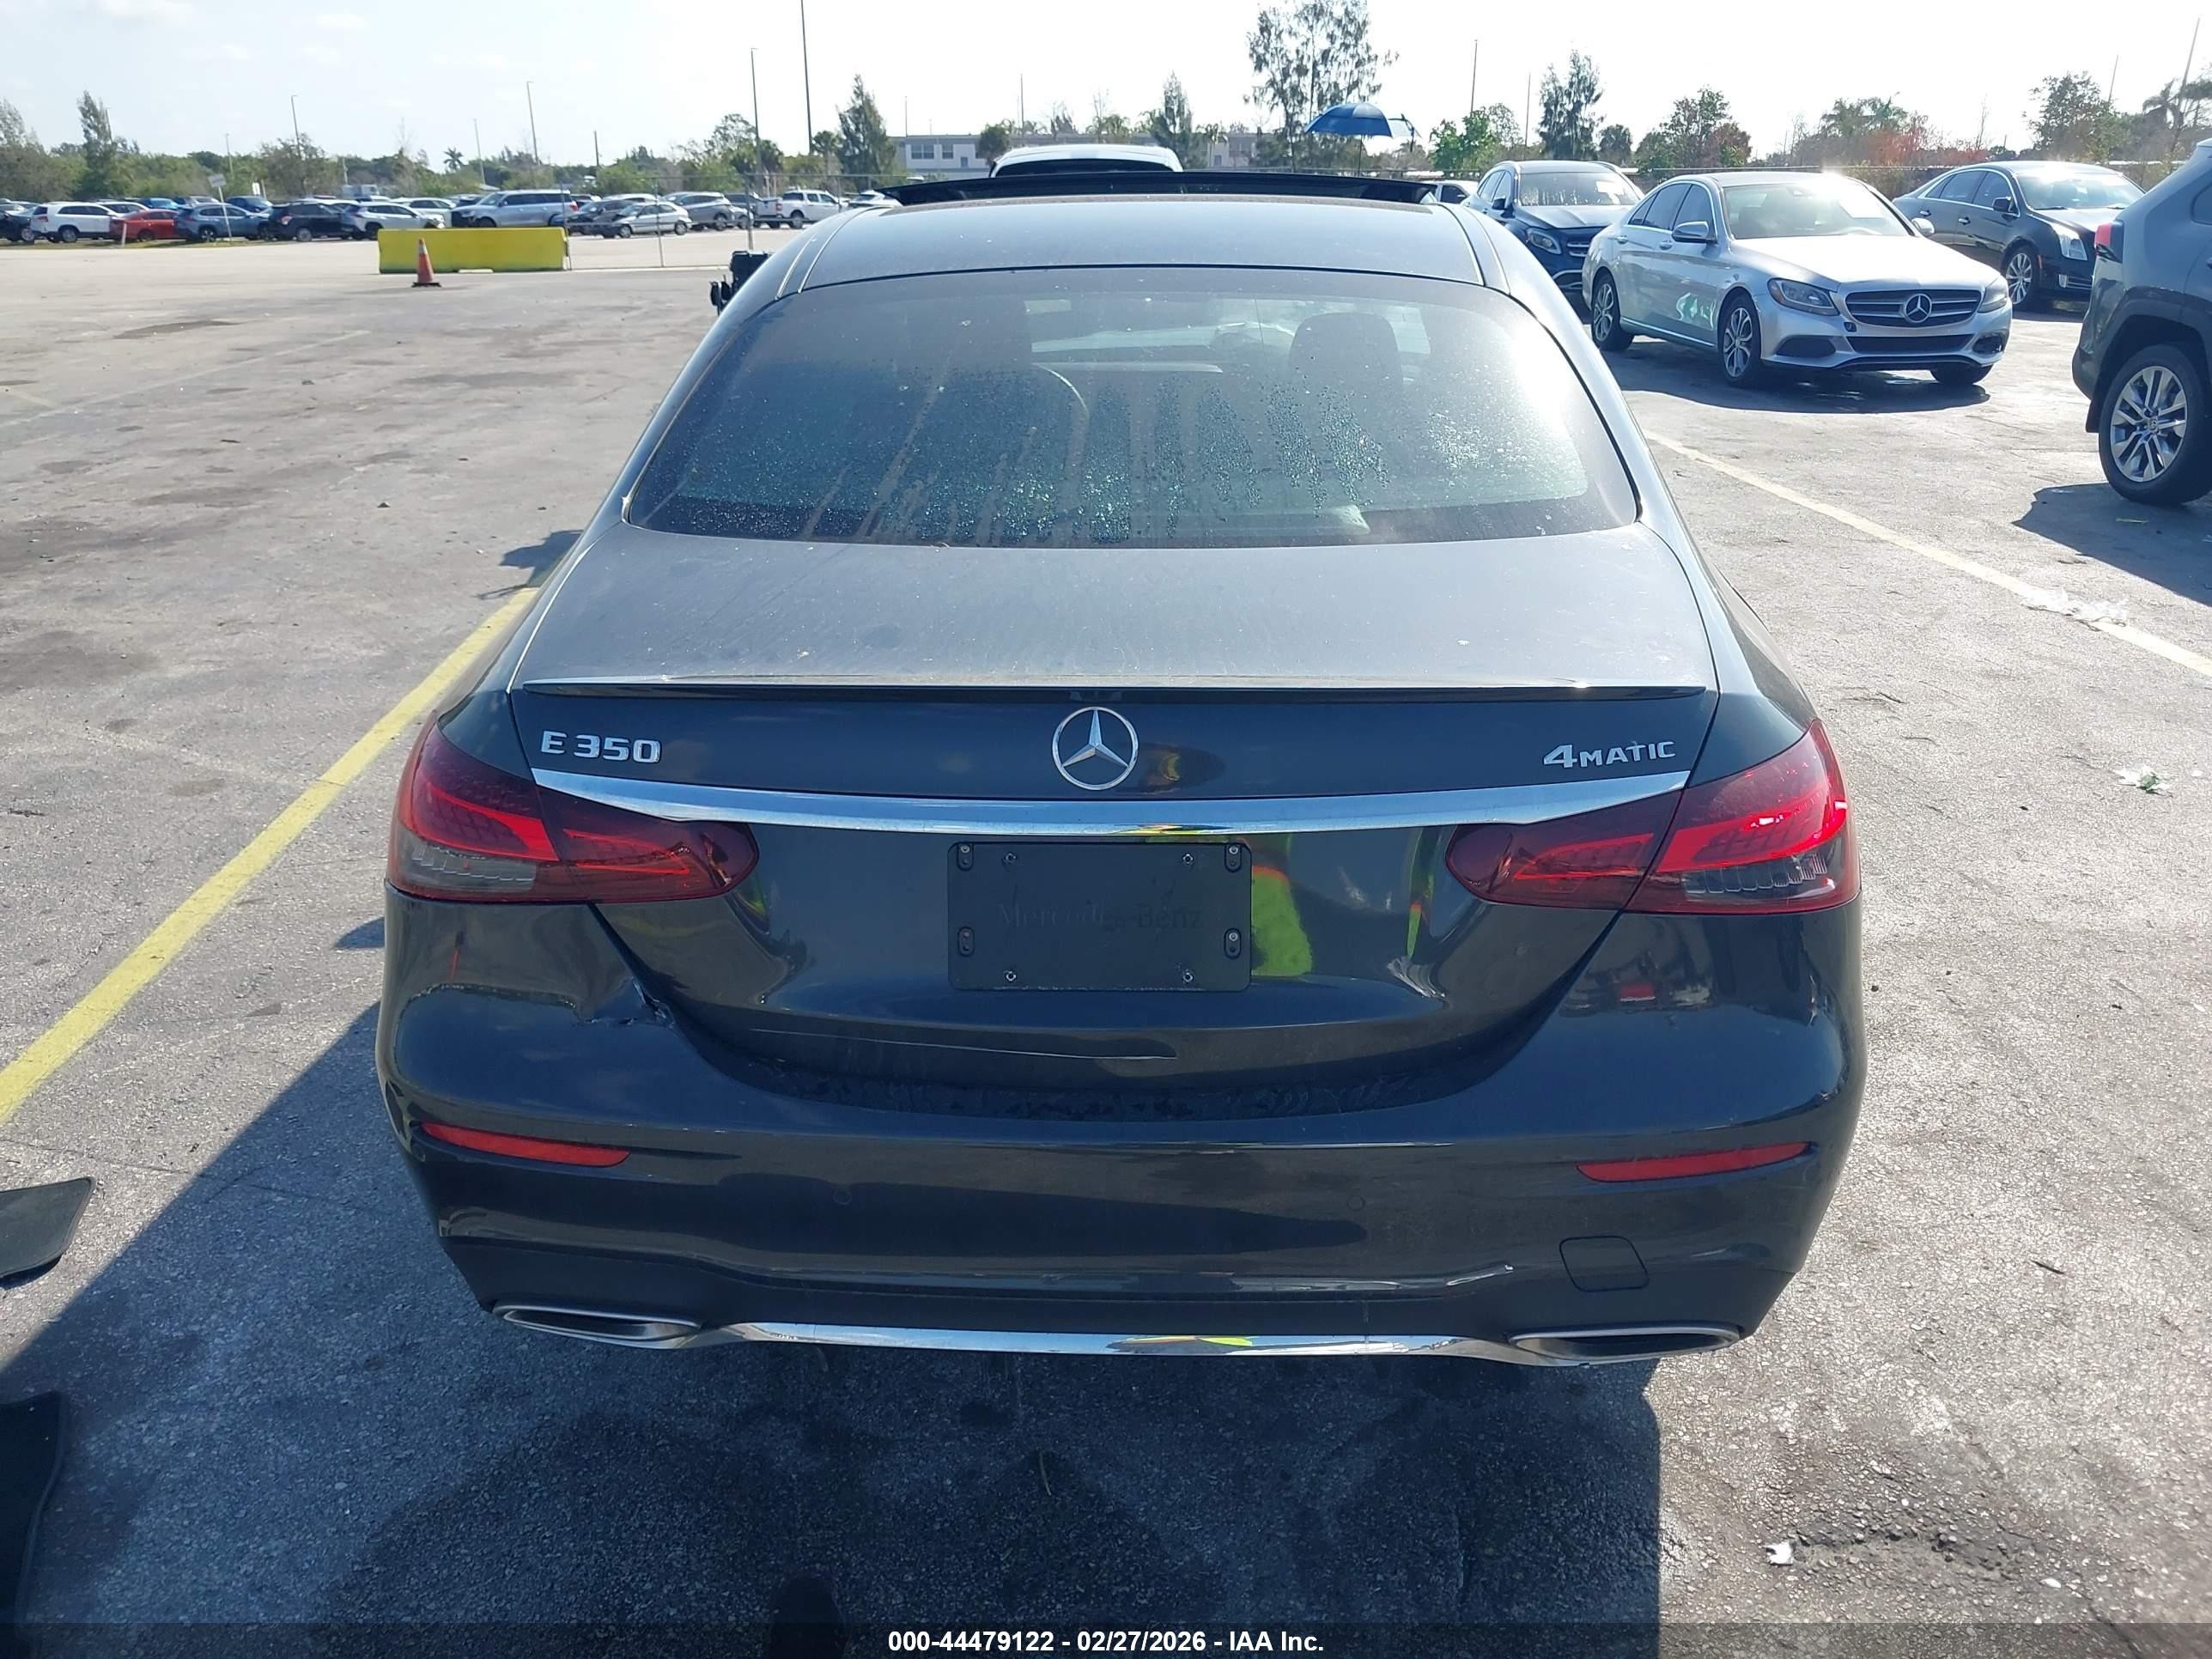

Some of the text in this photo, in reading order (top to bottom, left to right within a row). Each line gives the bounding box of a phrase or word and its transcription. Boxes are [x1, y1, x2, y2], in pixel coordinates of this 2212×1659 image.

[541, 730, 660, 763] E 350
[1543, 741, 1676, 768] 4MATIC
